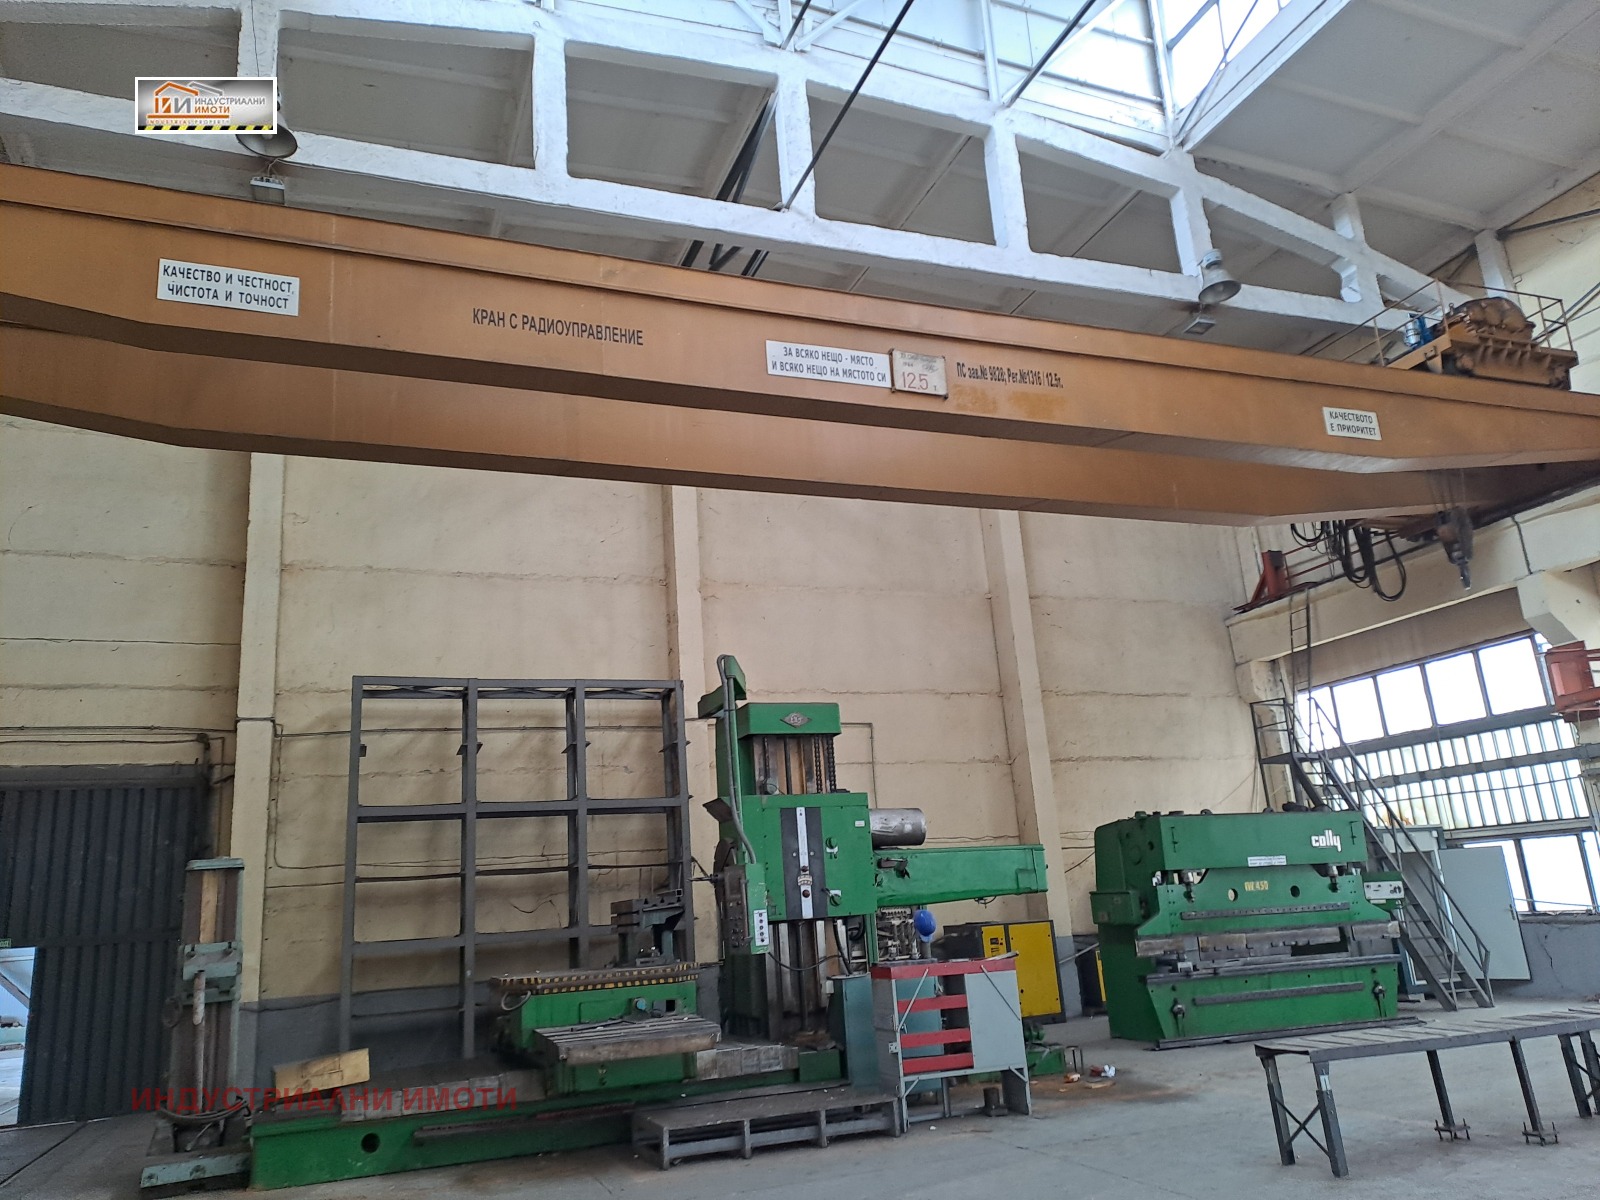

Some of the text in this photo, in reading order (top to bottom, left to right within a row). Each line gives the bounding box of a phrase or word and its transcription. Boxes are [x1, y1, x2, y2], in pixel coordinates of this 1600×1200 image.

[163, 264, 221, 283] КАЧЕСТВО
[225, 273, 233, 285] И
[167, 283, 289, 309] ЧИСТОТА И ТОЧНОСТ
[472, 307, 644, 346] КРАН С РАДИОУПРАВЛЕНИЕ
[783, 346, 793, 357] ЗА
[795, 347, 820, 360] ВСЯКО
[821, 351, 843, 363] НЕЩО
[850, 355, 874, 367] МЯСТО
[771, 360, 887, 383] И ВСЯКО НЕЩО НА МЯСТОТО СИ
[902, 371, 929, 390] 12.5
[1329, 411, 1373, 424] КАЧЕСТВОТО
[1330, 423, 1376, 436] Е ПРИОРИТЕТ
